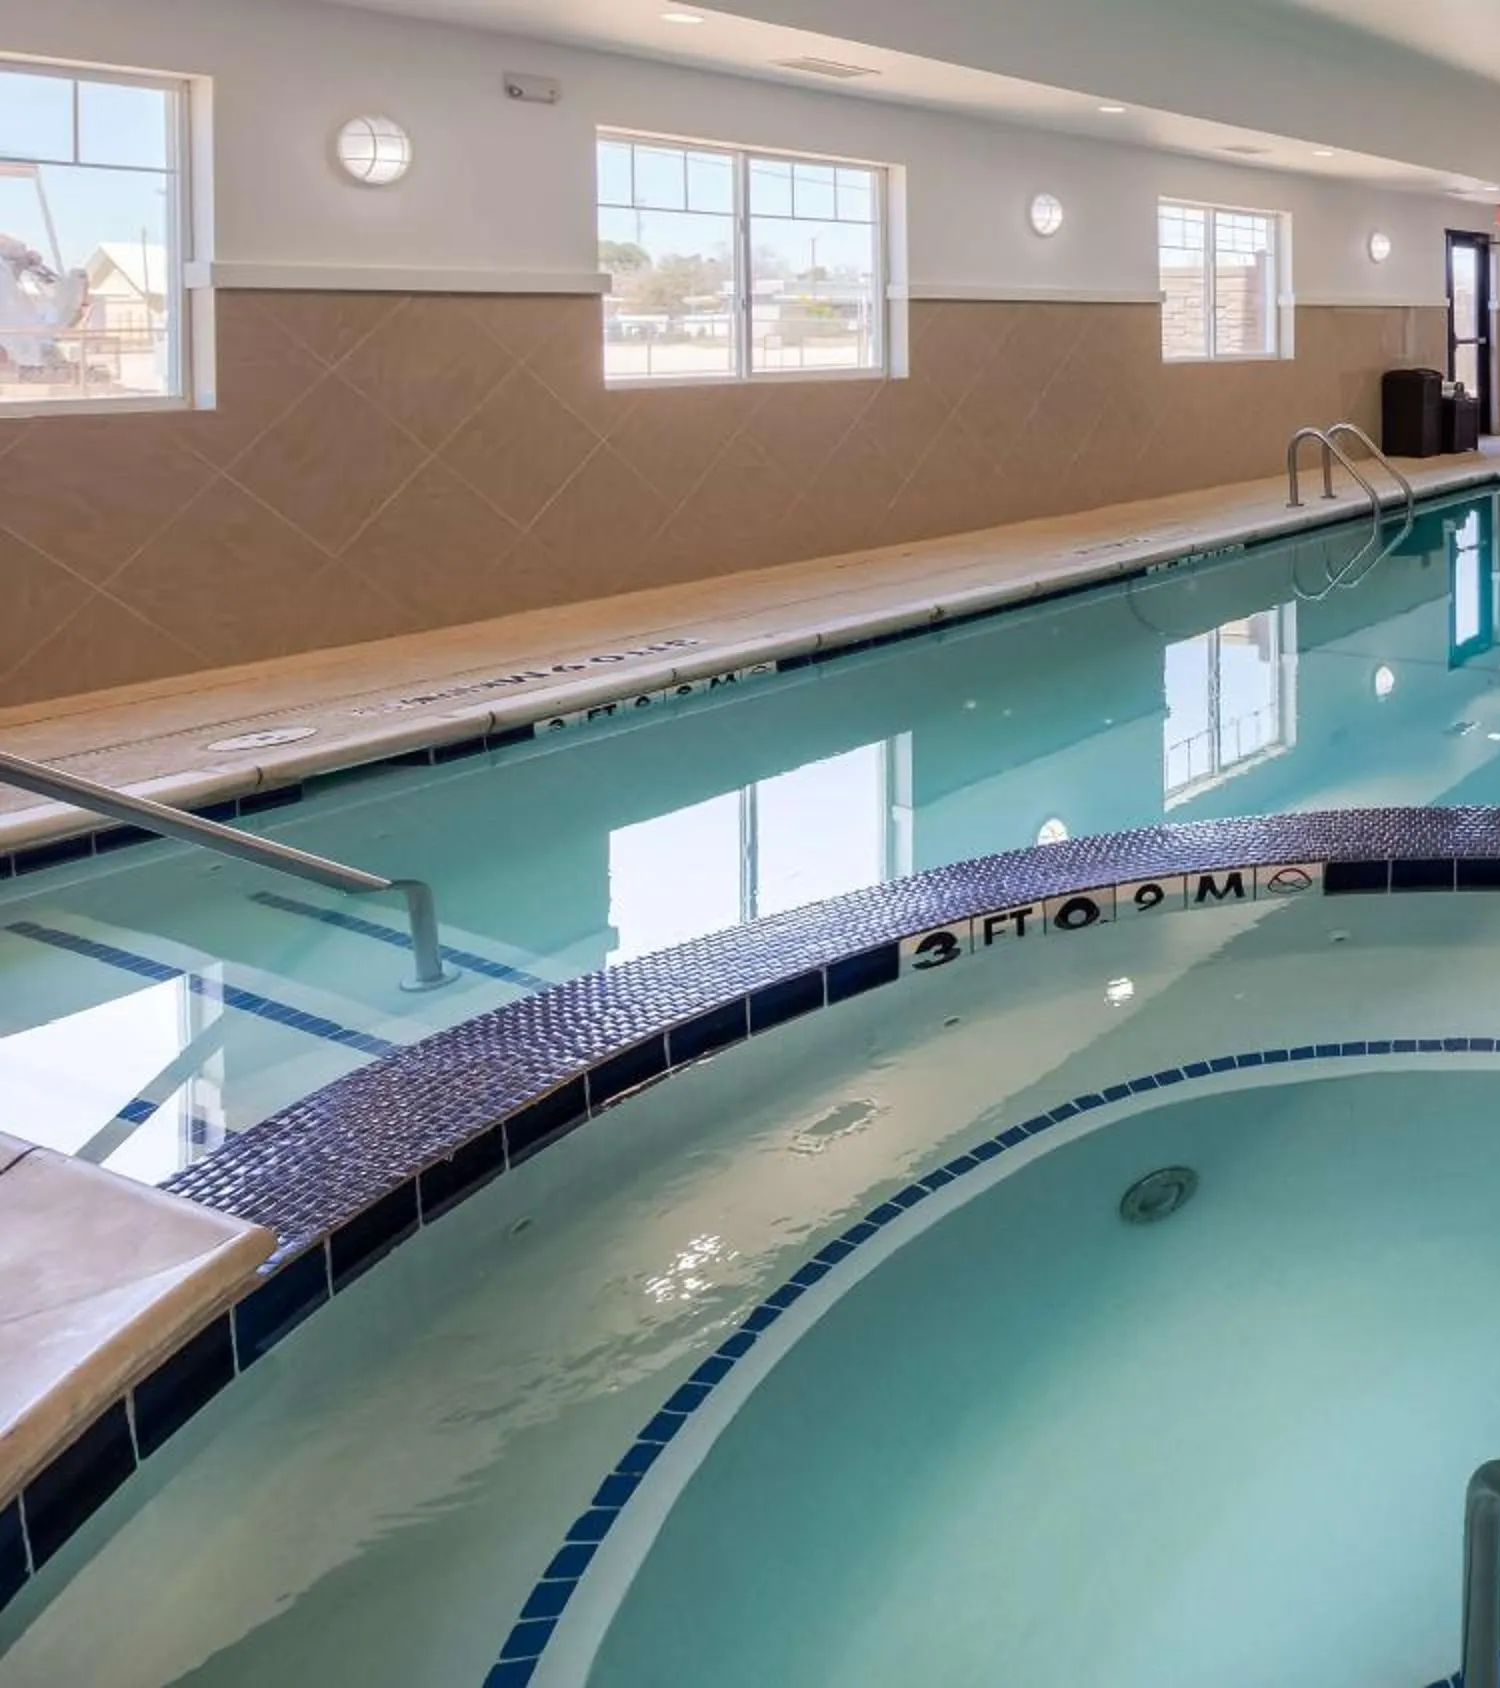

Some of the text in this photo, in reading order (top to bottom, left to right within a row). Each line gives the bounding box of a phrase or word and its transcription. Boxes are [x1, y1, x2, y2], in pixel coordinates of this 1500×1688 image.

[710, 673, 736, 689] M
[911, 931, 962, 970] 3
[984, 907, 1033, 946] FT
[1194, 872, 1245, 904] M
